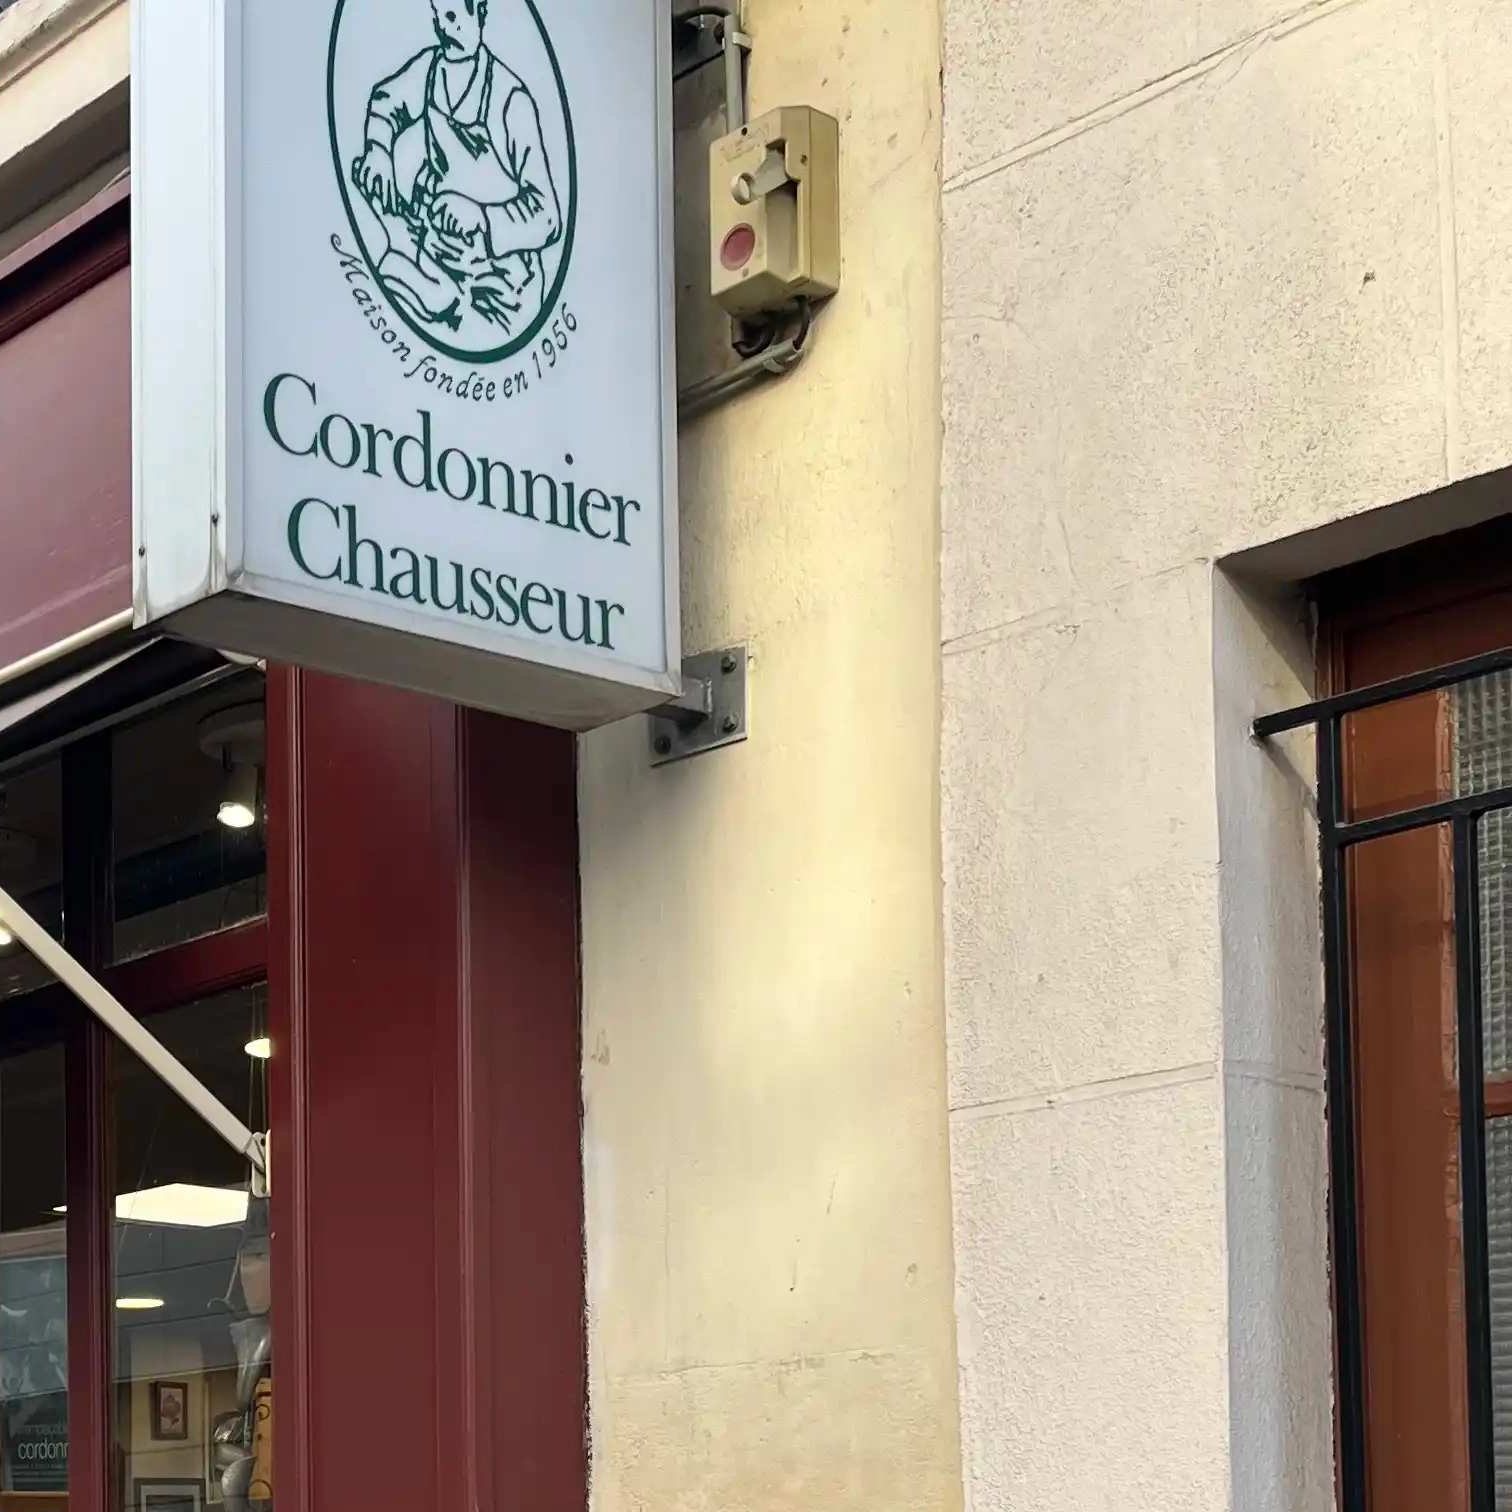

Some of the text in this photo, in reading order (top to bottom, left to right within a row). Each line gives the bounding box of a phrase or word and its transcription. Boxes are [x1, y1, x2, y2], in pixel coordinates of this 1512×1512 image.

[330, 233, 577, 401] Maison fondée en 1956
[263, 373, 641, 546] Cordonnier
[287, 498, 625, 650] Chausseur
